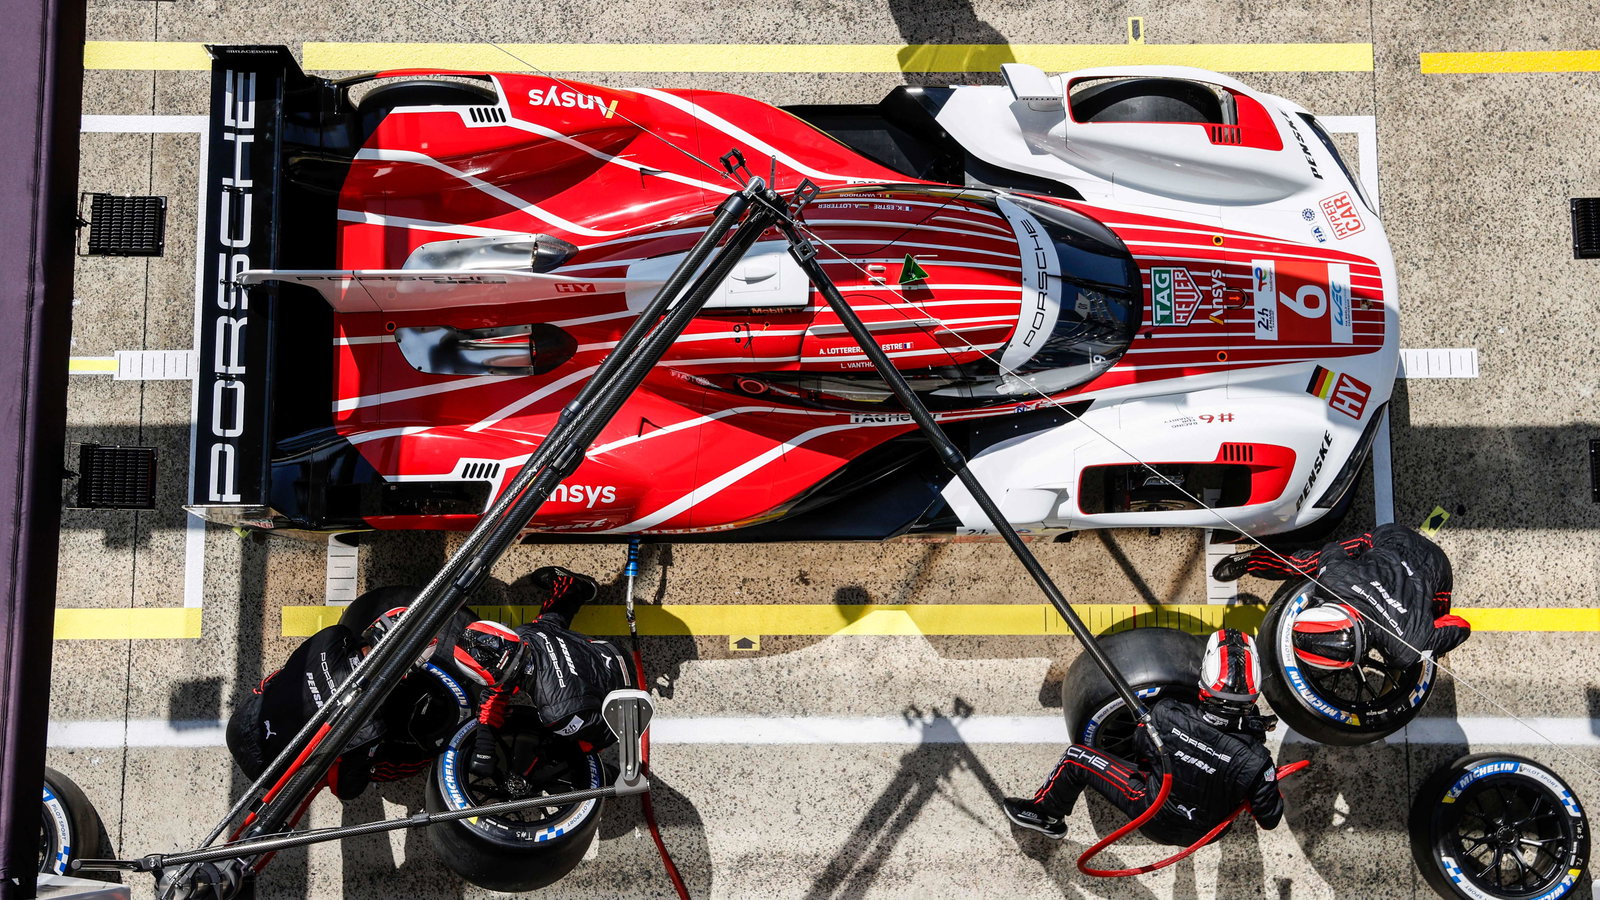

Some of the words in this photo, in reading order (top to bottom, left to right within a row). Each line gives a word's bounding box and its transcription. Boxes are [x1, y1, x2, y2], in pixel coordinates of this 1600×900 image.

[528, 85, 619, 119] Ansys
[1277, 107, 1324, 180] PENSKE
[1323, 201, 1347, 237] HYPER
[1334, 194, 1361, 232] CAR
[1313, 226, 1326, 243] FIA
[208, 69, 257, 503] PORSCHE
[558, 284, 592, 292] HY
[1021, 219, 1048, 347] PORSCHE
[1154, 273, 1170, 320] TAG
[1175, 271, 1197, 323] HEUER
[1209, 269, 1224, 325] Ansys
[1280, 285, 1327, 319] 6
[1257, 307, 1269, 331] 24h
[1331, 280, 1344, 326] WEC
[827, 346, 862, 355] LOTTERER
[882, 343, 903, 351] ESTRE
[1333, 376, 1366, 418] HY
[1296, 429, 1332, 512] PENSKE
[546, 484, 616, 509] nsys
[1351, 584, 1404, 636] PORSCHE
[1370, 580, 1408, 614] PENSKE
[321, 652, 338, 695] PORSC
[537, 631, 566, 688] PORSCHE
[556, 635, 579, 676] PENSKE
[306, 672, 325, 709] PENSK
[430, 668, 468, 705] MICHELIN
[1289, 670, 1338, 716] MICHELIN
[1172, 727, 1232, 763] PORSCHE
[1174, 750, 1217, 776] PENSKE
[445, 750, 465, 804] MICHELIN
[1459, 763, 1515, 788] MICHELIN
[1523, 767, 1540, 776] PILOT
[1540, 774, 1558, 788] SPORT
[51, 803, 63, 819] PILOT
[59, 820, 67, 841] SPORT
